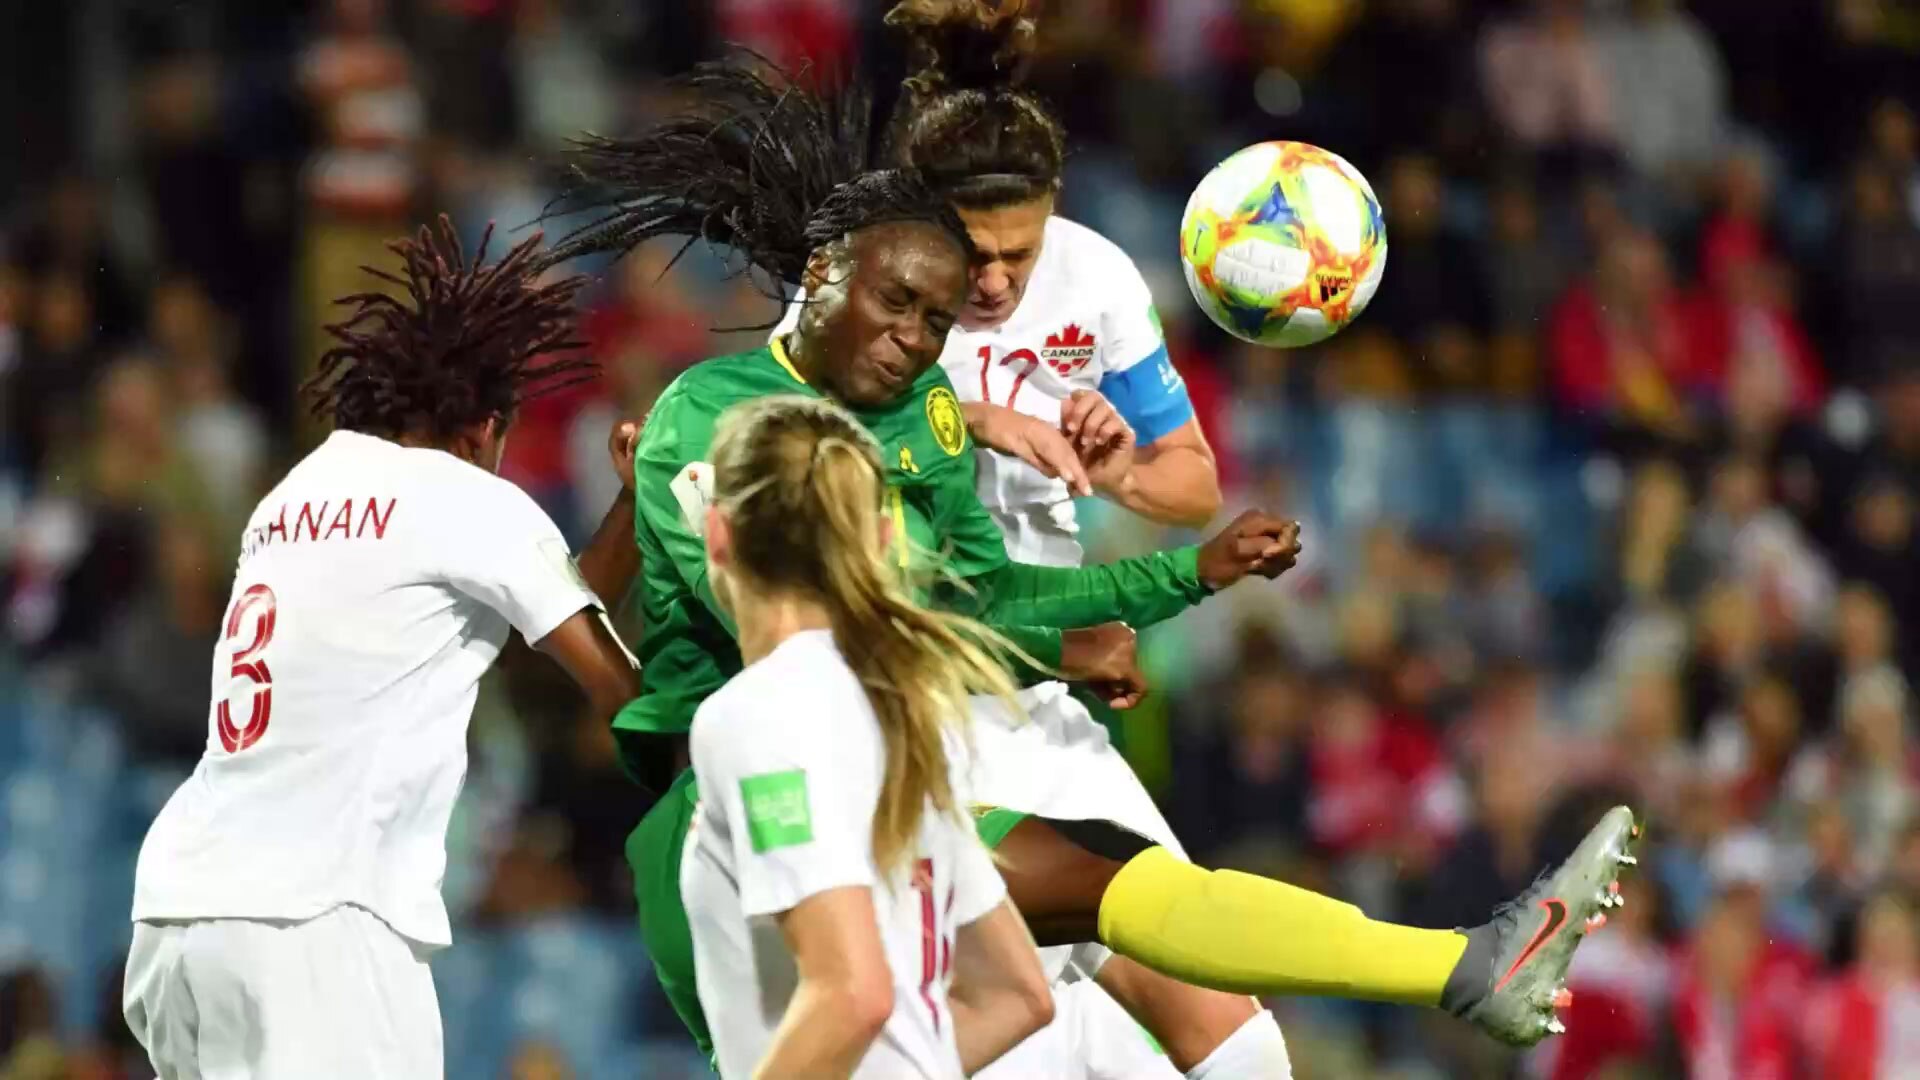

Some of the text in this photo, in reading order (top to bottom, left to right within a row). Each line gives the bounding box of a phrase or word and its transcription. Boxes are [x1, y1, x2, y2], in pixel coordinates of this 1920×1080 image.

[1041, 348, 1094, 358] CANADA
[243, 497, 396, 555] HANAN
[217, 583, 277, 754] 3
